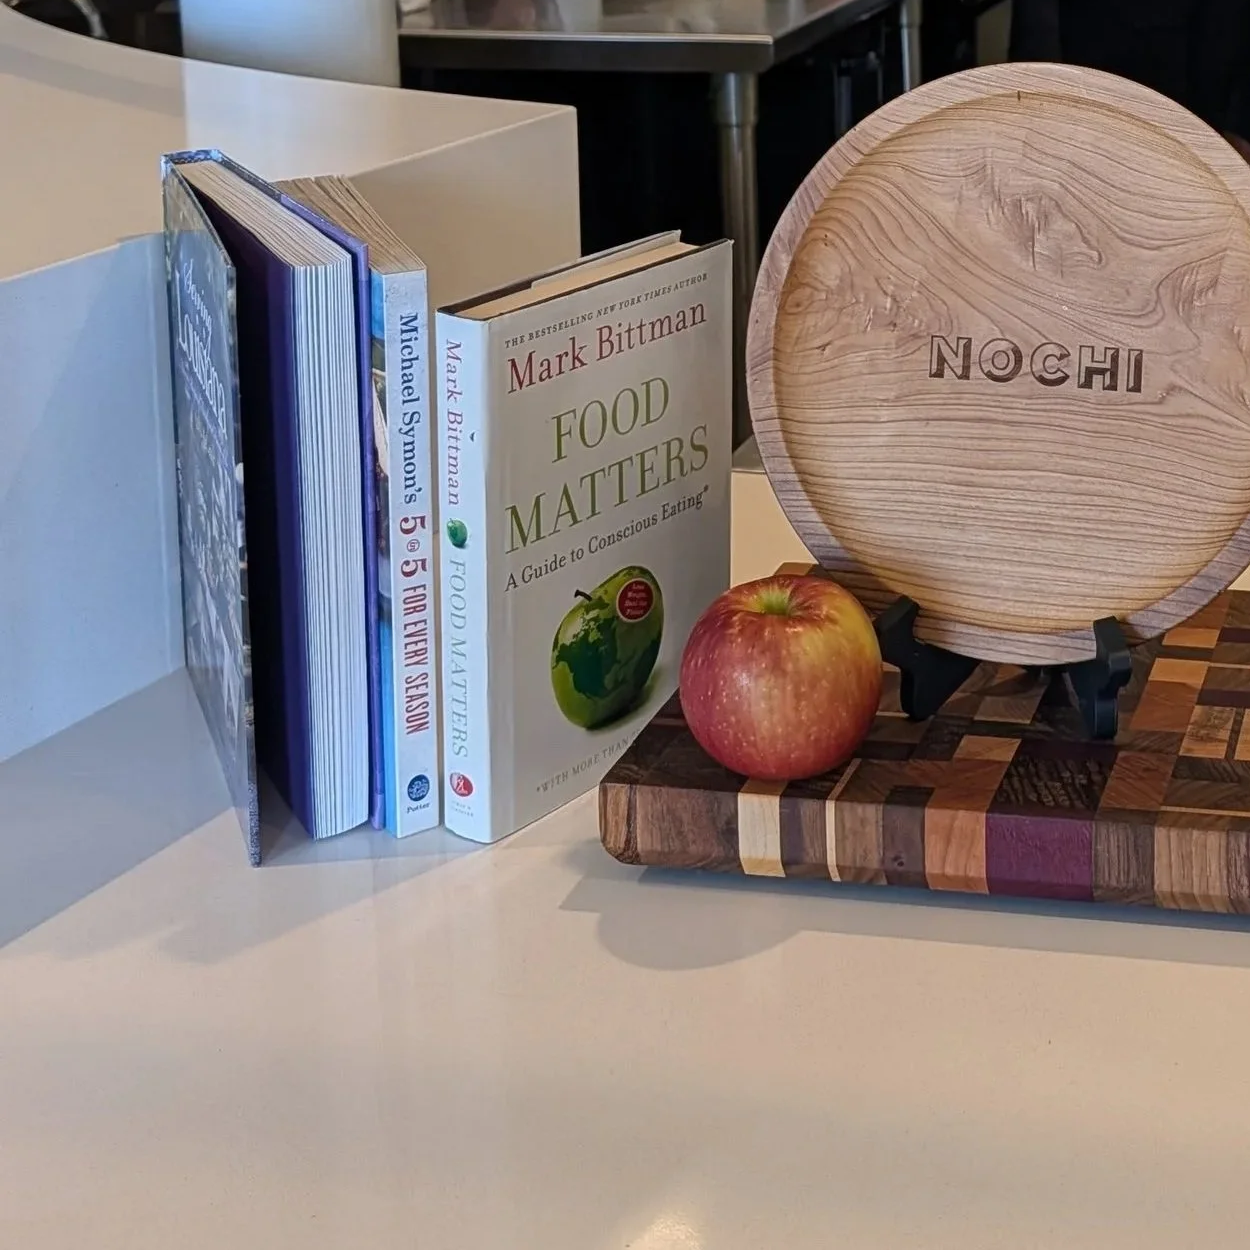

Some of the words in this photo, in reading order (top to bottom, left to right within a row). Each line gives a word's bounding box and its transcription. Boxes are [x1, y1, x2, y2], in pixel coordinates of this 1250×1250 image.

[505, 335, 525, 349] THE
[528, 312, 593, 341] BESTSELLING
[596, 304, 616, 318] NEW
[619, 295, 642, 311] YORK
[644, 285, 672, 301] TIMES
[673, 273, 708, 291] AUTHOR
[400, 312, 420, 406] Michael
[446, 338, 464, 404] Mark
[508, 336, 588, 394] Mark
[596, 302, 707, 361] Bittman
[929, 335, 1143, 393] NOCHI
[552, 377, 669, 463] FOOD
[398, 411, 423, 505] Symon's
[446, 408, 464, 506] Bittman
[505, 424, 709, 554] MATTERS
[400, 515, 426, 535] 5
[505, 573, 518, 592] A
[521, 553, 567, 584] Guide
[570, 547, 584, 561] to
[588, 513, 658, 554] Conscious
[400, 557, 427, 578] 5
[403, 584, 427, 617] FOR
[449, 559, 466, 630] FOOD
[403, 618, 429, 668] EVERY
[404, 672, 430, 735] SEASON
[449, 637, 468, 758] MATTERS
[572, 754, 600, 775] MORE
[602, 736, 629, 758] THAN
[406, 803, 430, 814] Potter
